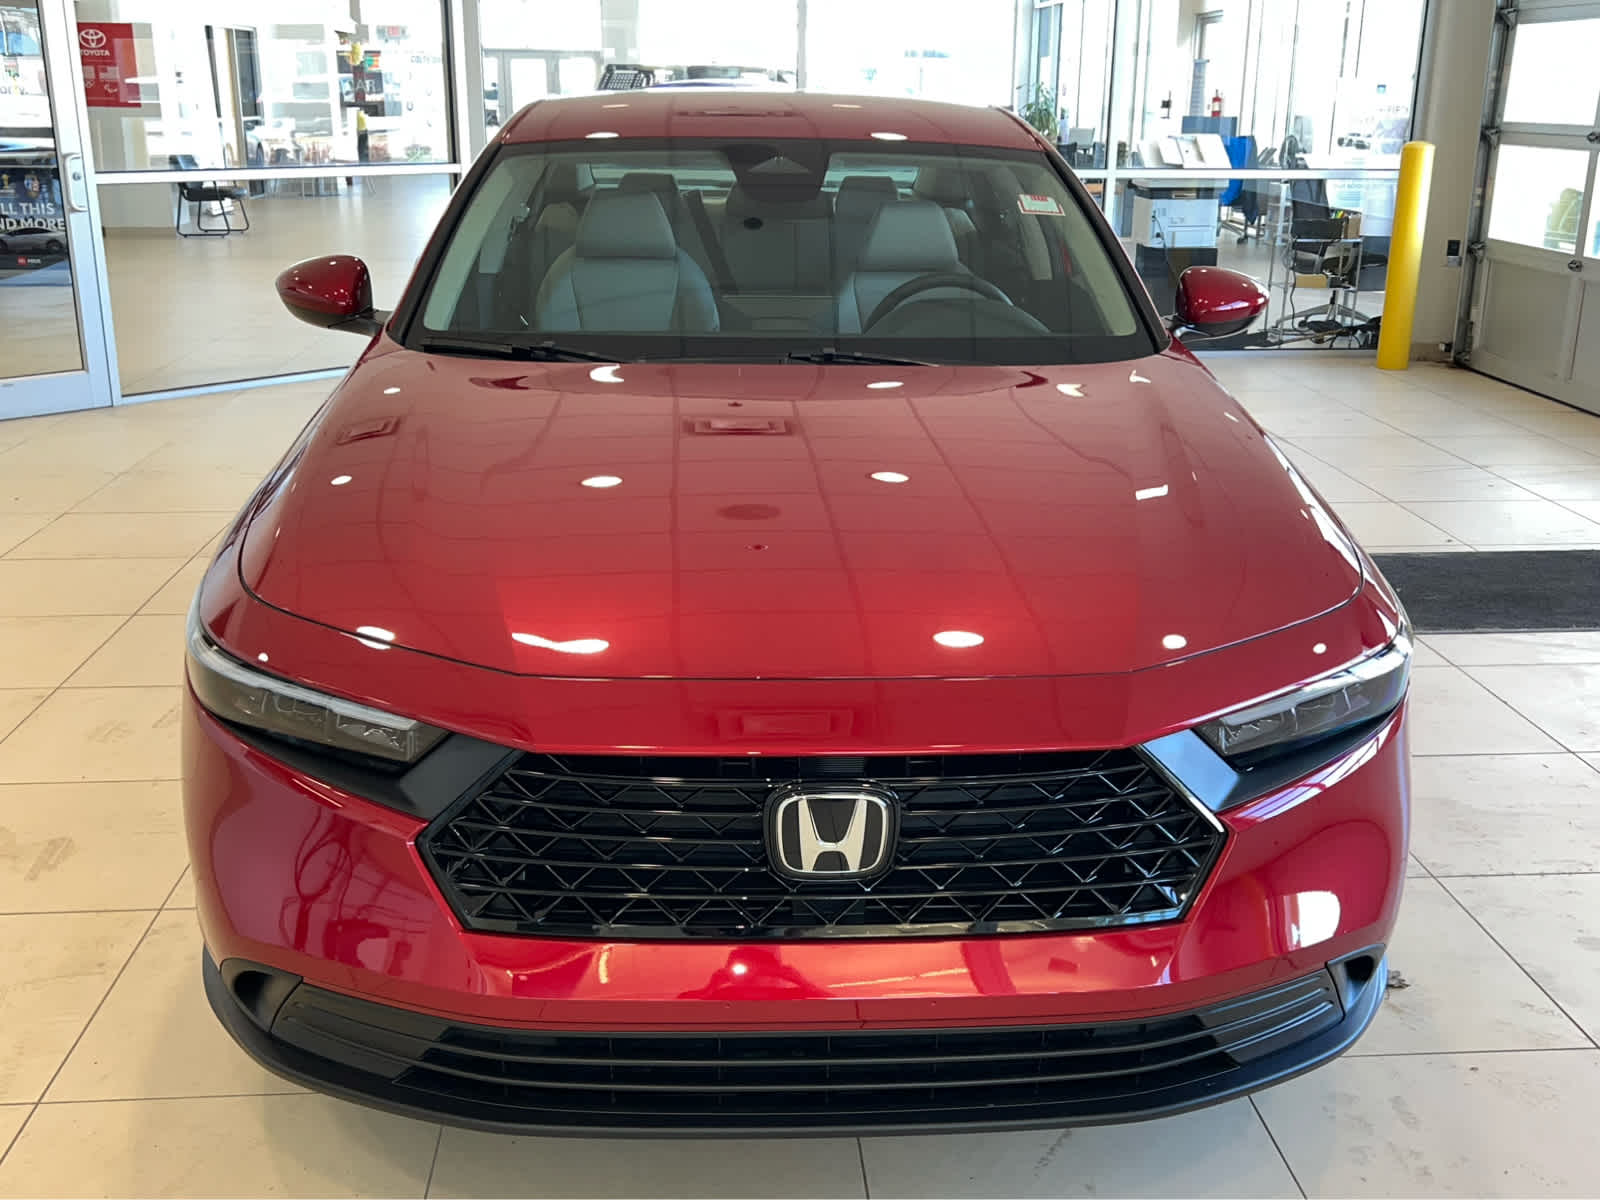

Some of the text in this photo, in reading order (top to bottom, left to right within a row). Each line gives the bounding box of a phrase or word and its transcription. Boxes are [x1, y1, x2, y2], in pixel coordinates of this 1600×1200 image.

[0, 203, 55, 215] LL THIS
[0, 217, 65, 230] ND MORE
